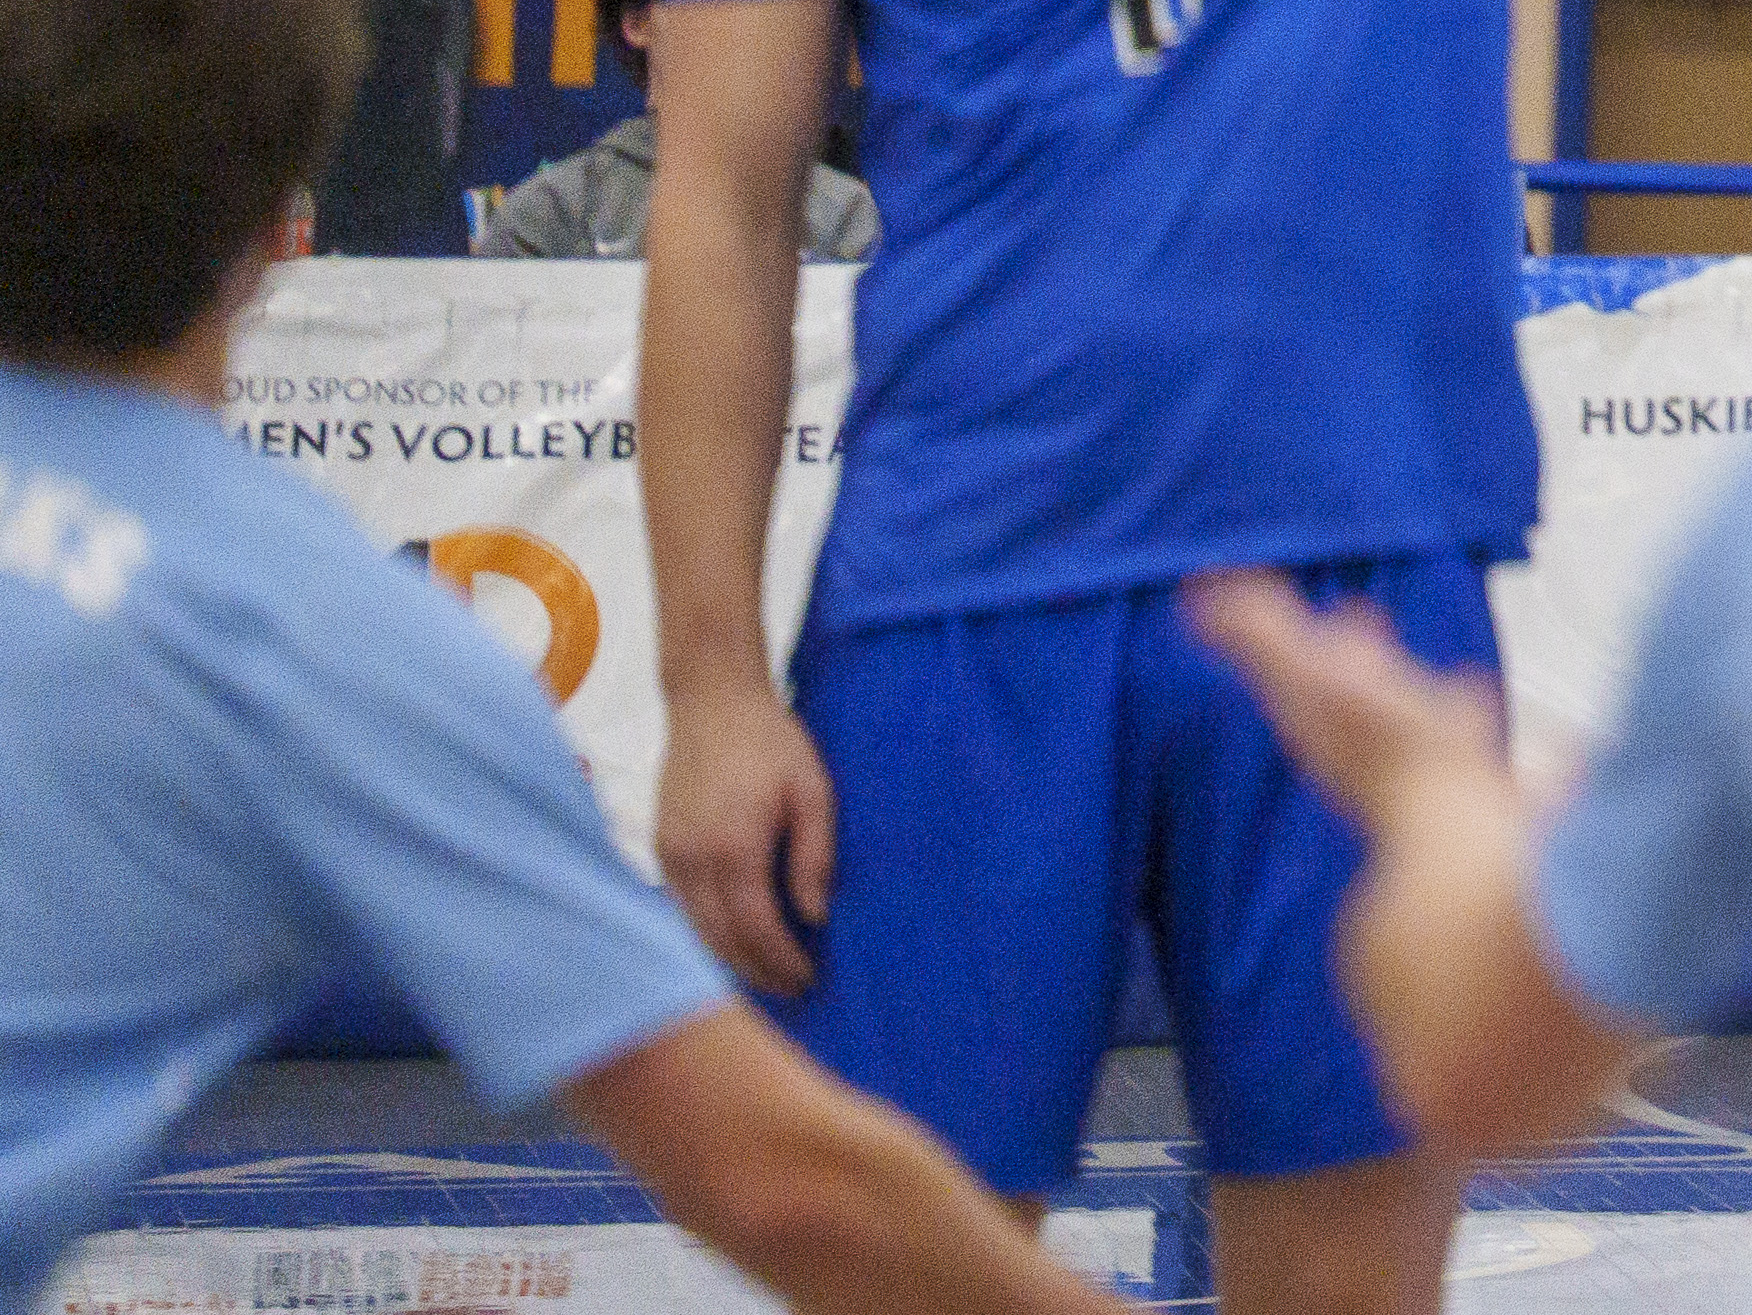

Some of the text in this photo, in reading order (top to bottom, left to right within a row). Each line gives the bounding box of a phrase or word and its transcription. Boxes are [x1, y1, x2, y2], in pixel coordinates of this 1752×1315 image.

[219, 375, 296, 405] OUD
[304, 375, 468, 408] SPONSOR
[477, 378, 524, 407] OF
[390, 419, 638, 464] VOLLEYB
